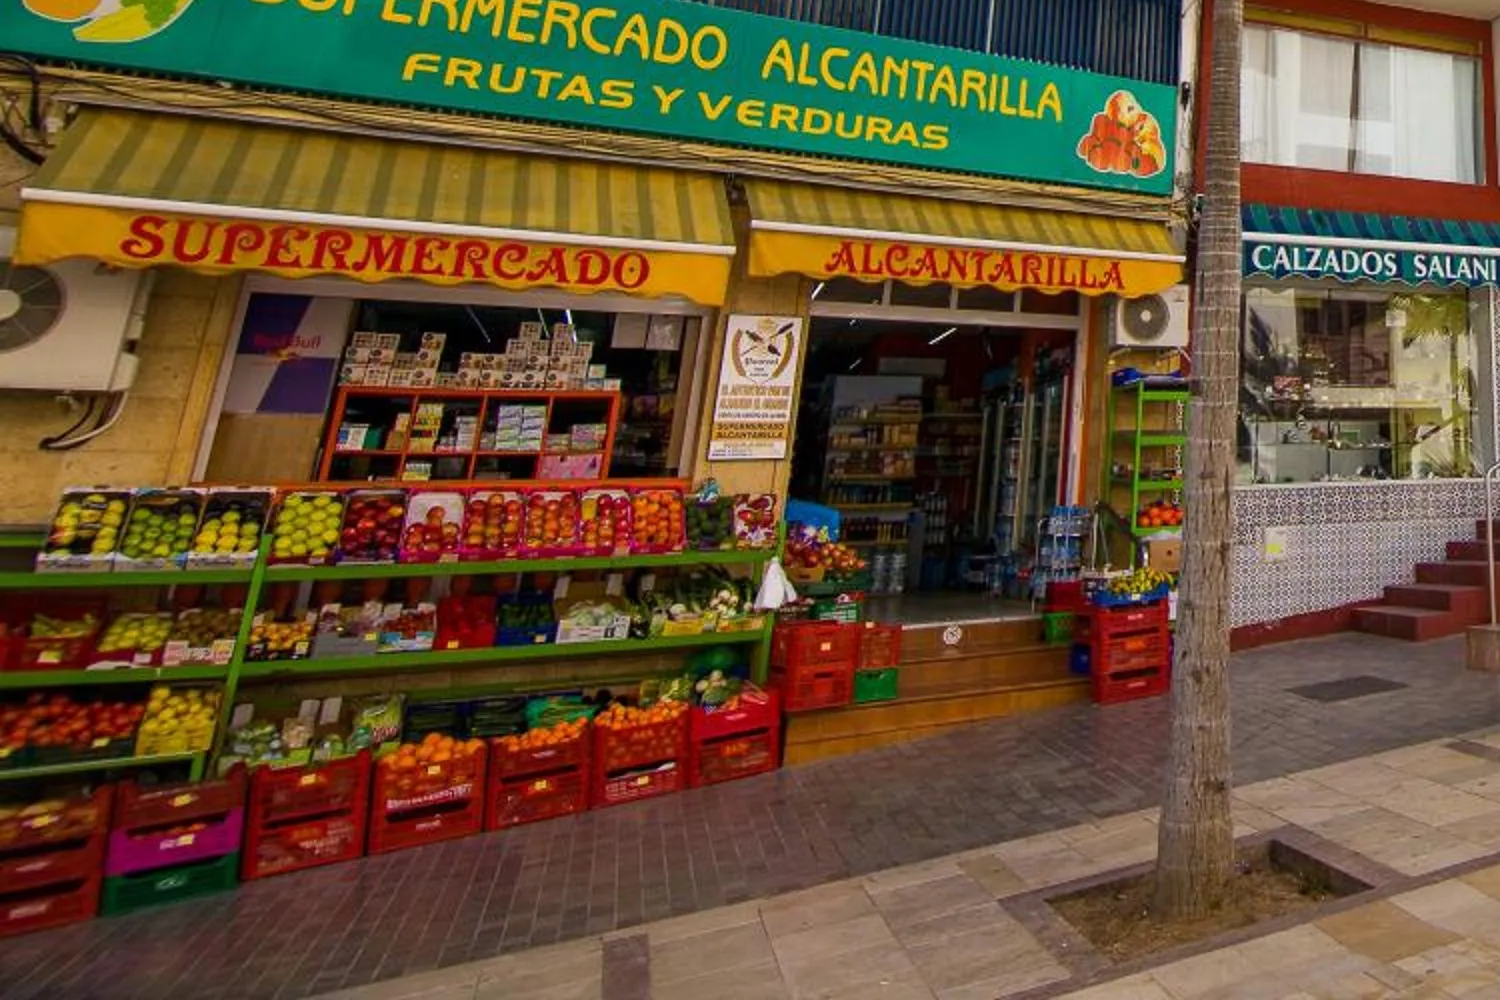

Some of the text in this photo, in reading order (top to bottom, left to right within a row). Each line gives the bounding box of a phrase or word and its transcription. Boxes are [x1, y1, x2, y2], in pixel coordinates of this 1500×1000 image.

[403, 53, 949, 150] FRUTAS Y VERDURAS
[761, 37, 1063, 122] ALCANTARILLA
[120, 214, 651, 290] SUPERMERCADO
[824, 240, 1126, 291] ALCANTARILLA
[1252, 244, 1498, 281] CALZADOS SALANI
